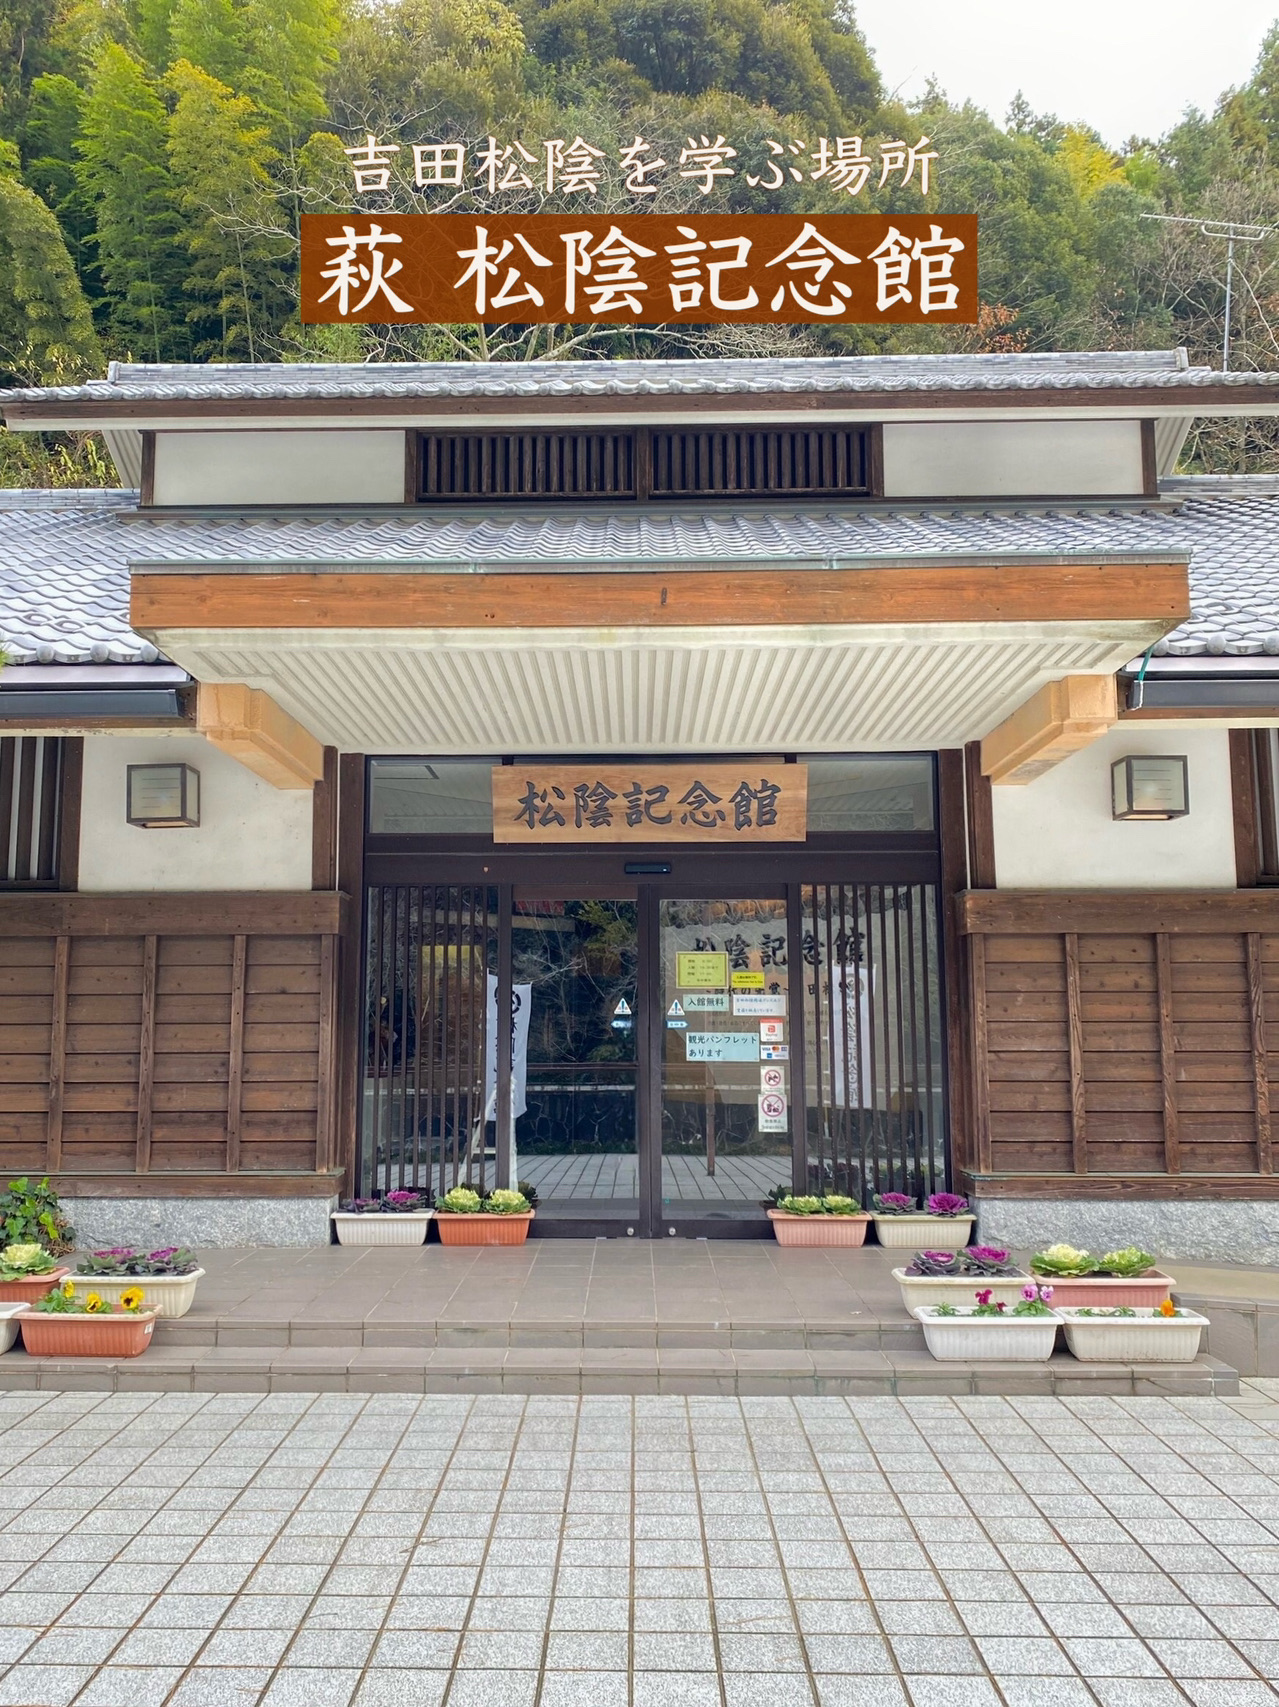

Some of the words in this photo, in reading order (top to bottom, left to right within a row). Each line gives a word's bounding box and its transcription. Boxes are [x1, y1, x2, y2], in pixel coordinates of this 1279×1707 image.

[513, 779, 783, 831] 松陰記念館
[688, 997, 725, 1007] 入館無料
[688, 1035, 757, 1045] 観光パンフレット
[688, 1048, 723, 1058] あります
